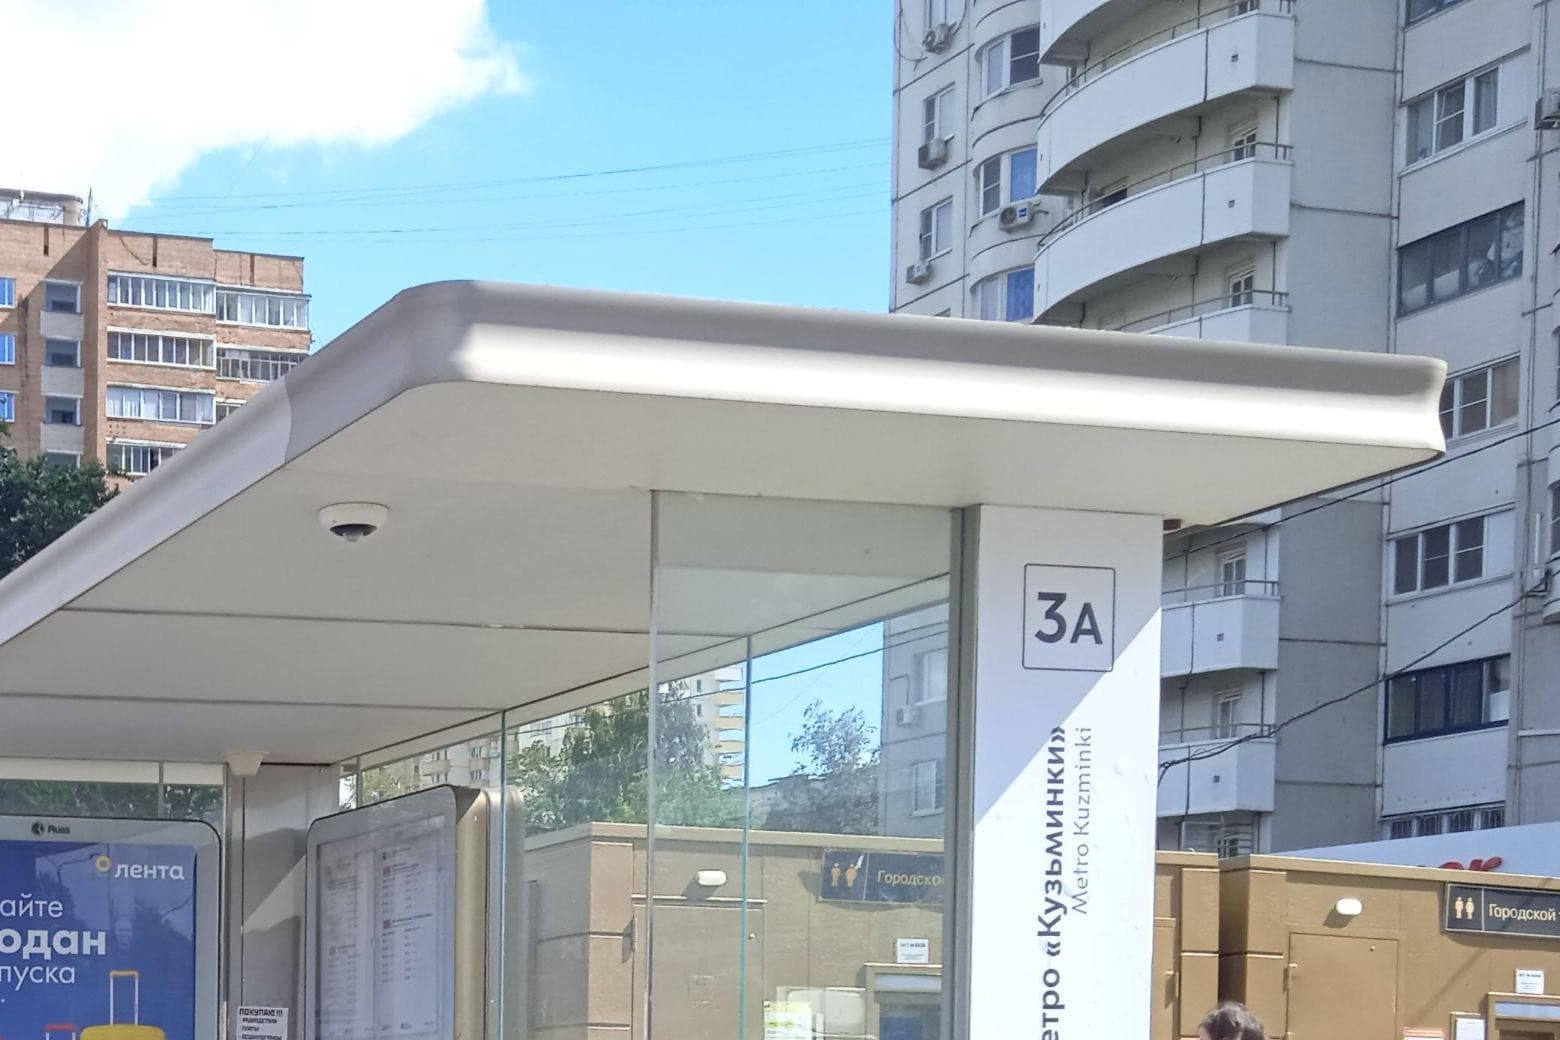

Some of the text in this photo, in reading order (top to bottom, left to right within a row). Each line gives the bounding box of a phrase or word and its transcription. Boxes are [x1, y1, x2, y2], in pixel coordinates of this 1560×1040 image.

[47, 824, 71, 834] Russ
[1071, 726, 1092, 915] Metro Kuzminki
[1037, 725, 1068, 957] «Кузьминки»
[114, 862, 185, 881] лента
[877, 869, 944, 887] Городско
[1488, 904, 1557, 922] Городской
